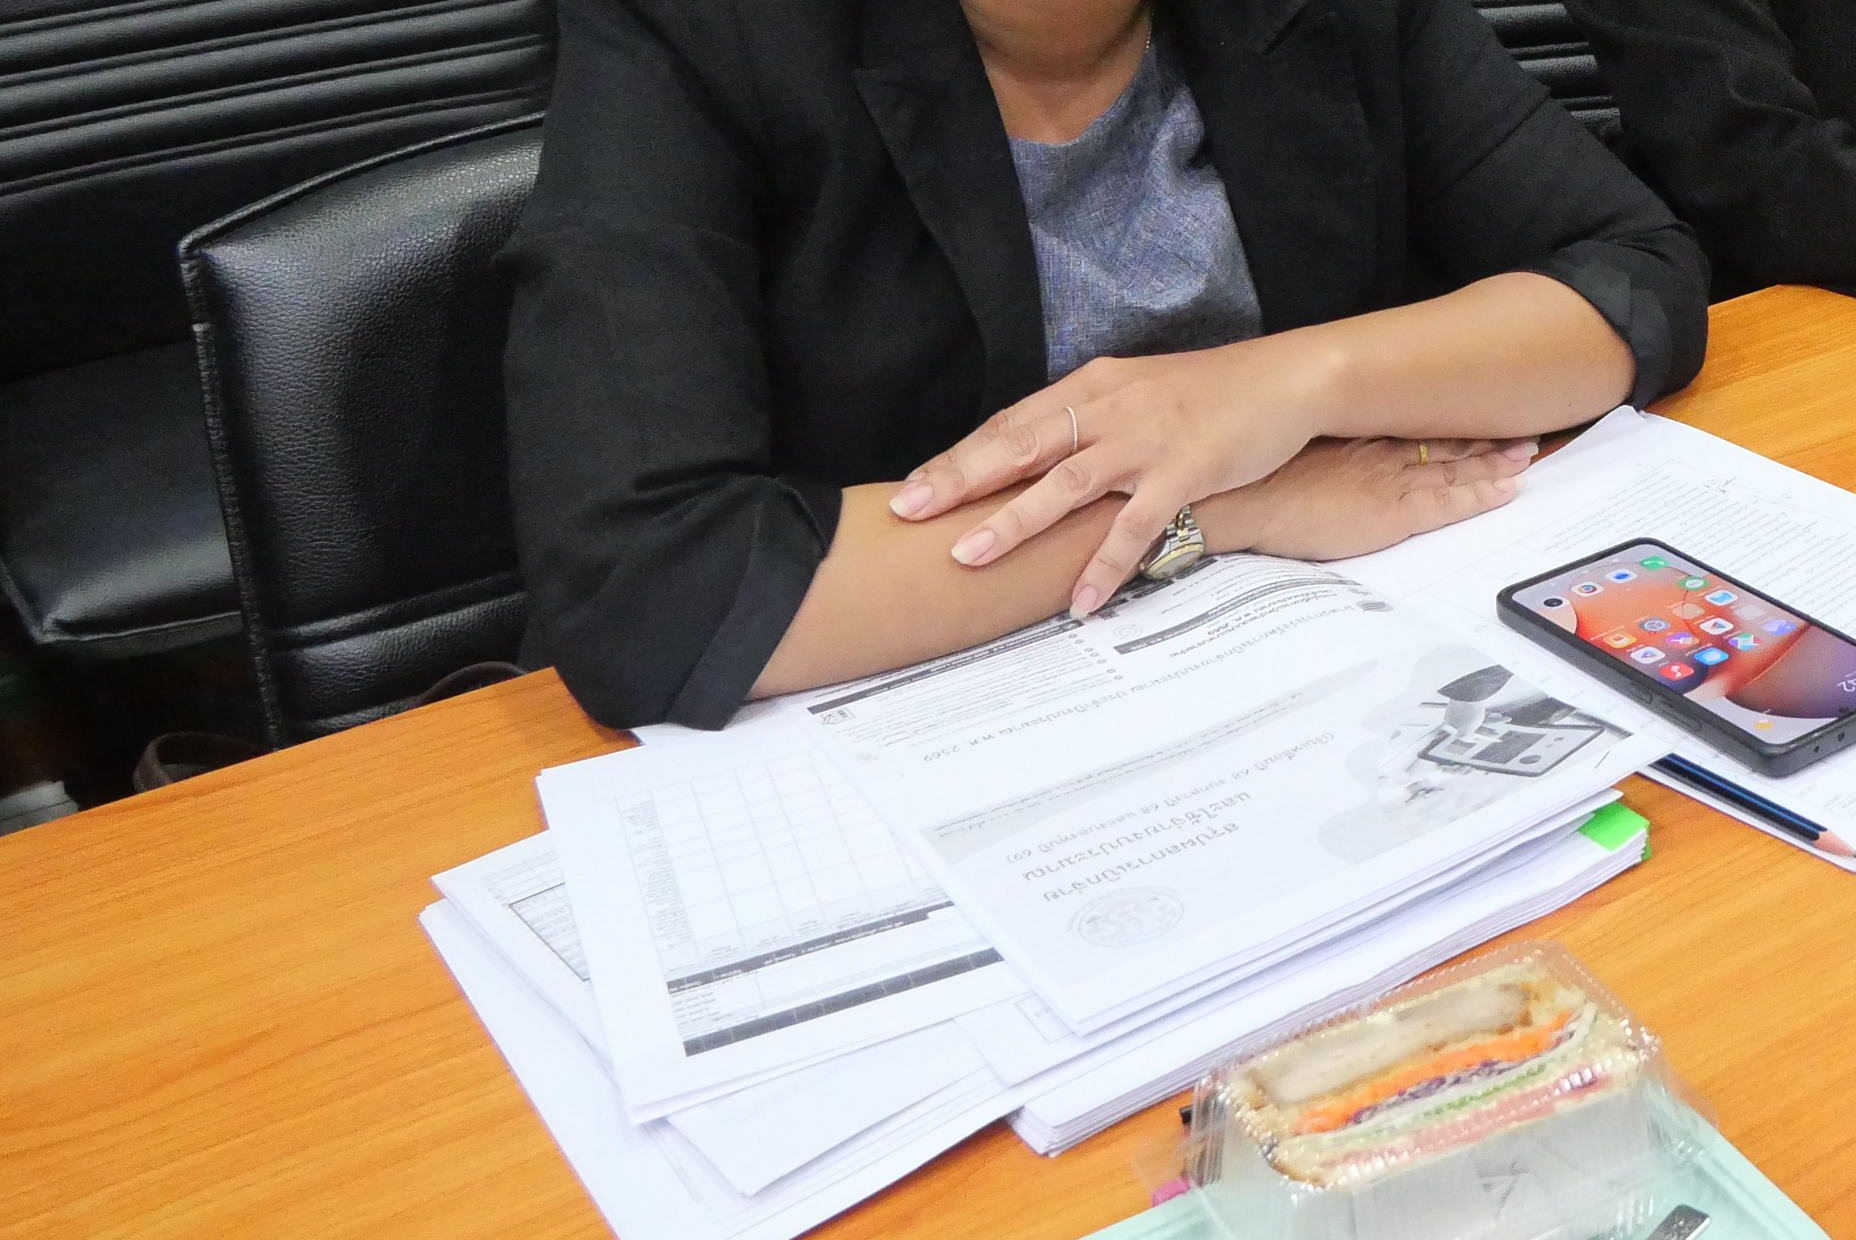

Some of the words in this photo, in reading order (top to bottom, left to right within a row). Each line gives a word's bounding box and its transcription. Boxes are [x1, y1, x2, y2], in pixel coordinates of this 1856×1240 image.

[922, 742, 961, 762] 2569
[1230, 767, 1250, 782] 68
[1139, 802, 1160, 817] 68
[1021, 790, 1252, 882] และใช้จ่ายงบประมาณ
[1004, 848, 1033, 865] 69)
[1042, 820, 1240, 903] สรุปผลการเบิกจ่าย
